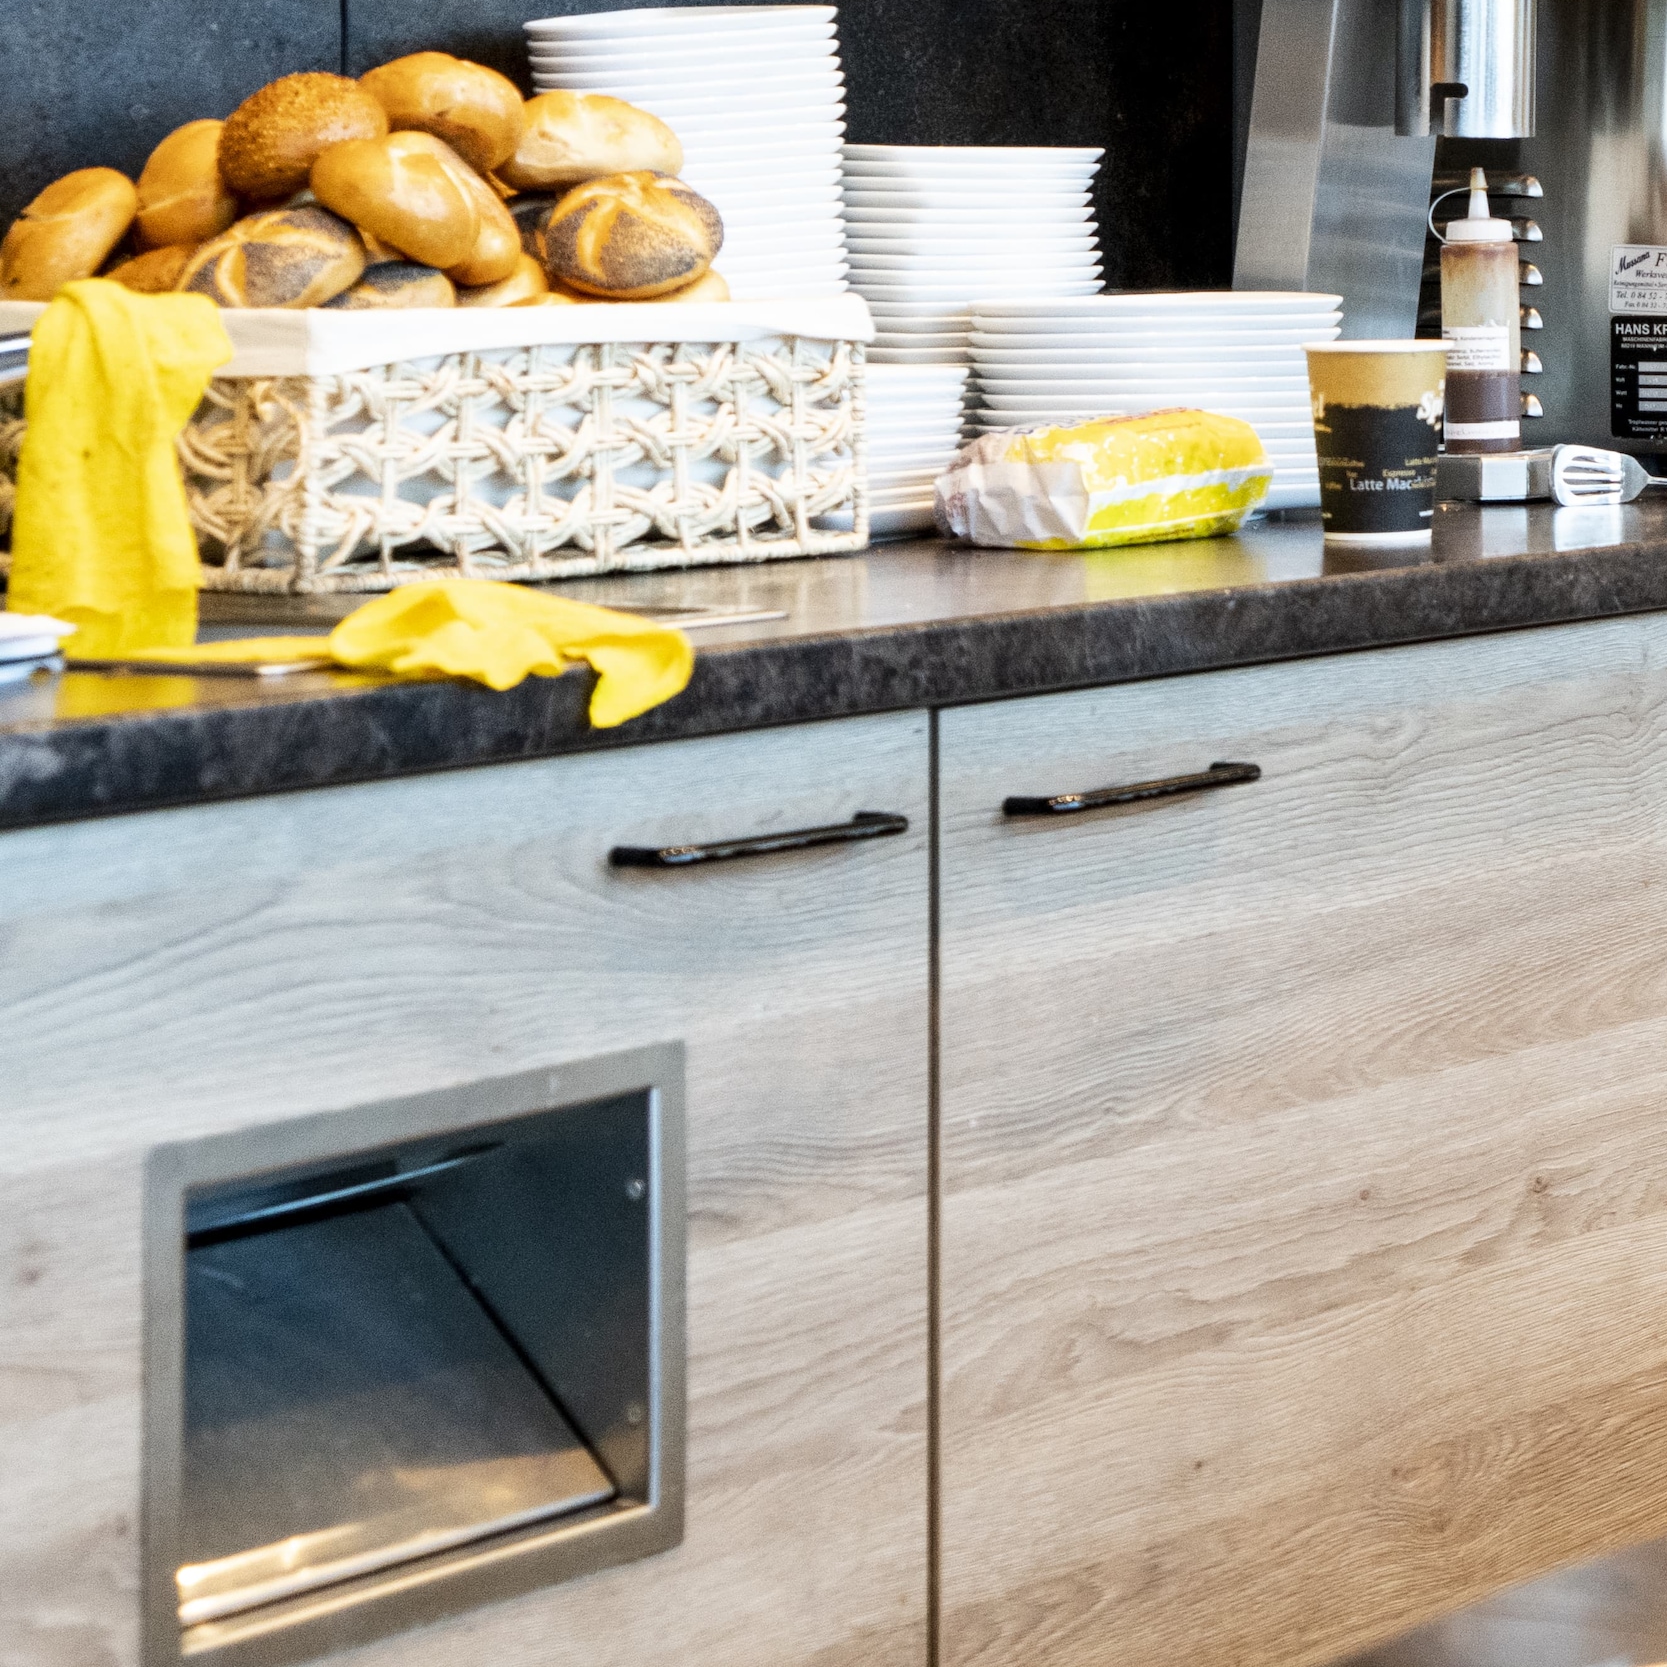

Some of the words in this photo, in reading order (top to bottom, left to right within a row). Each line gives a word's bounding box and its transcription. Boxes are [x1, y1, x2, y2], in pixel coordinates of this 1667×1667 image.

[1616, 291, 1628, 299] Tel.
[1615, 323, 1650, 335] HANS
[1382, 468, 1416, 478] Espresso
[1350, 479, 1384, 491] Latte
